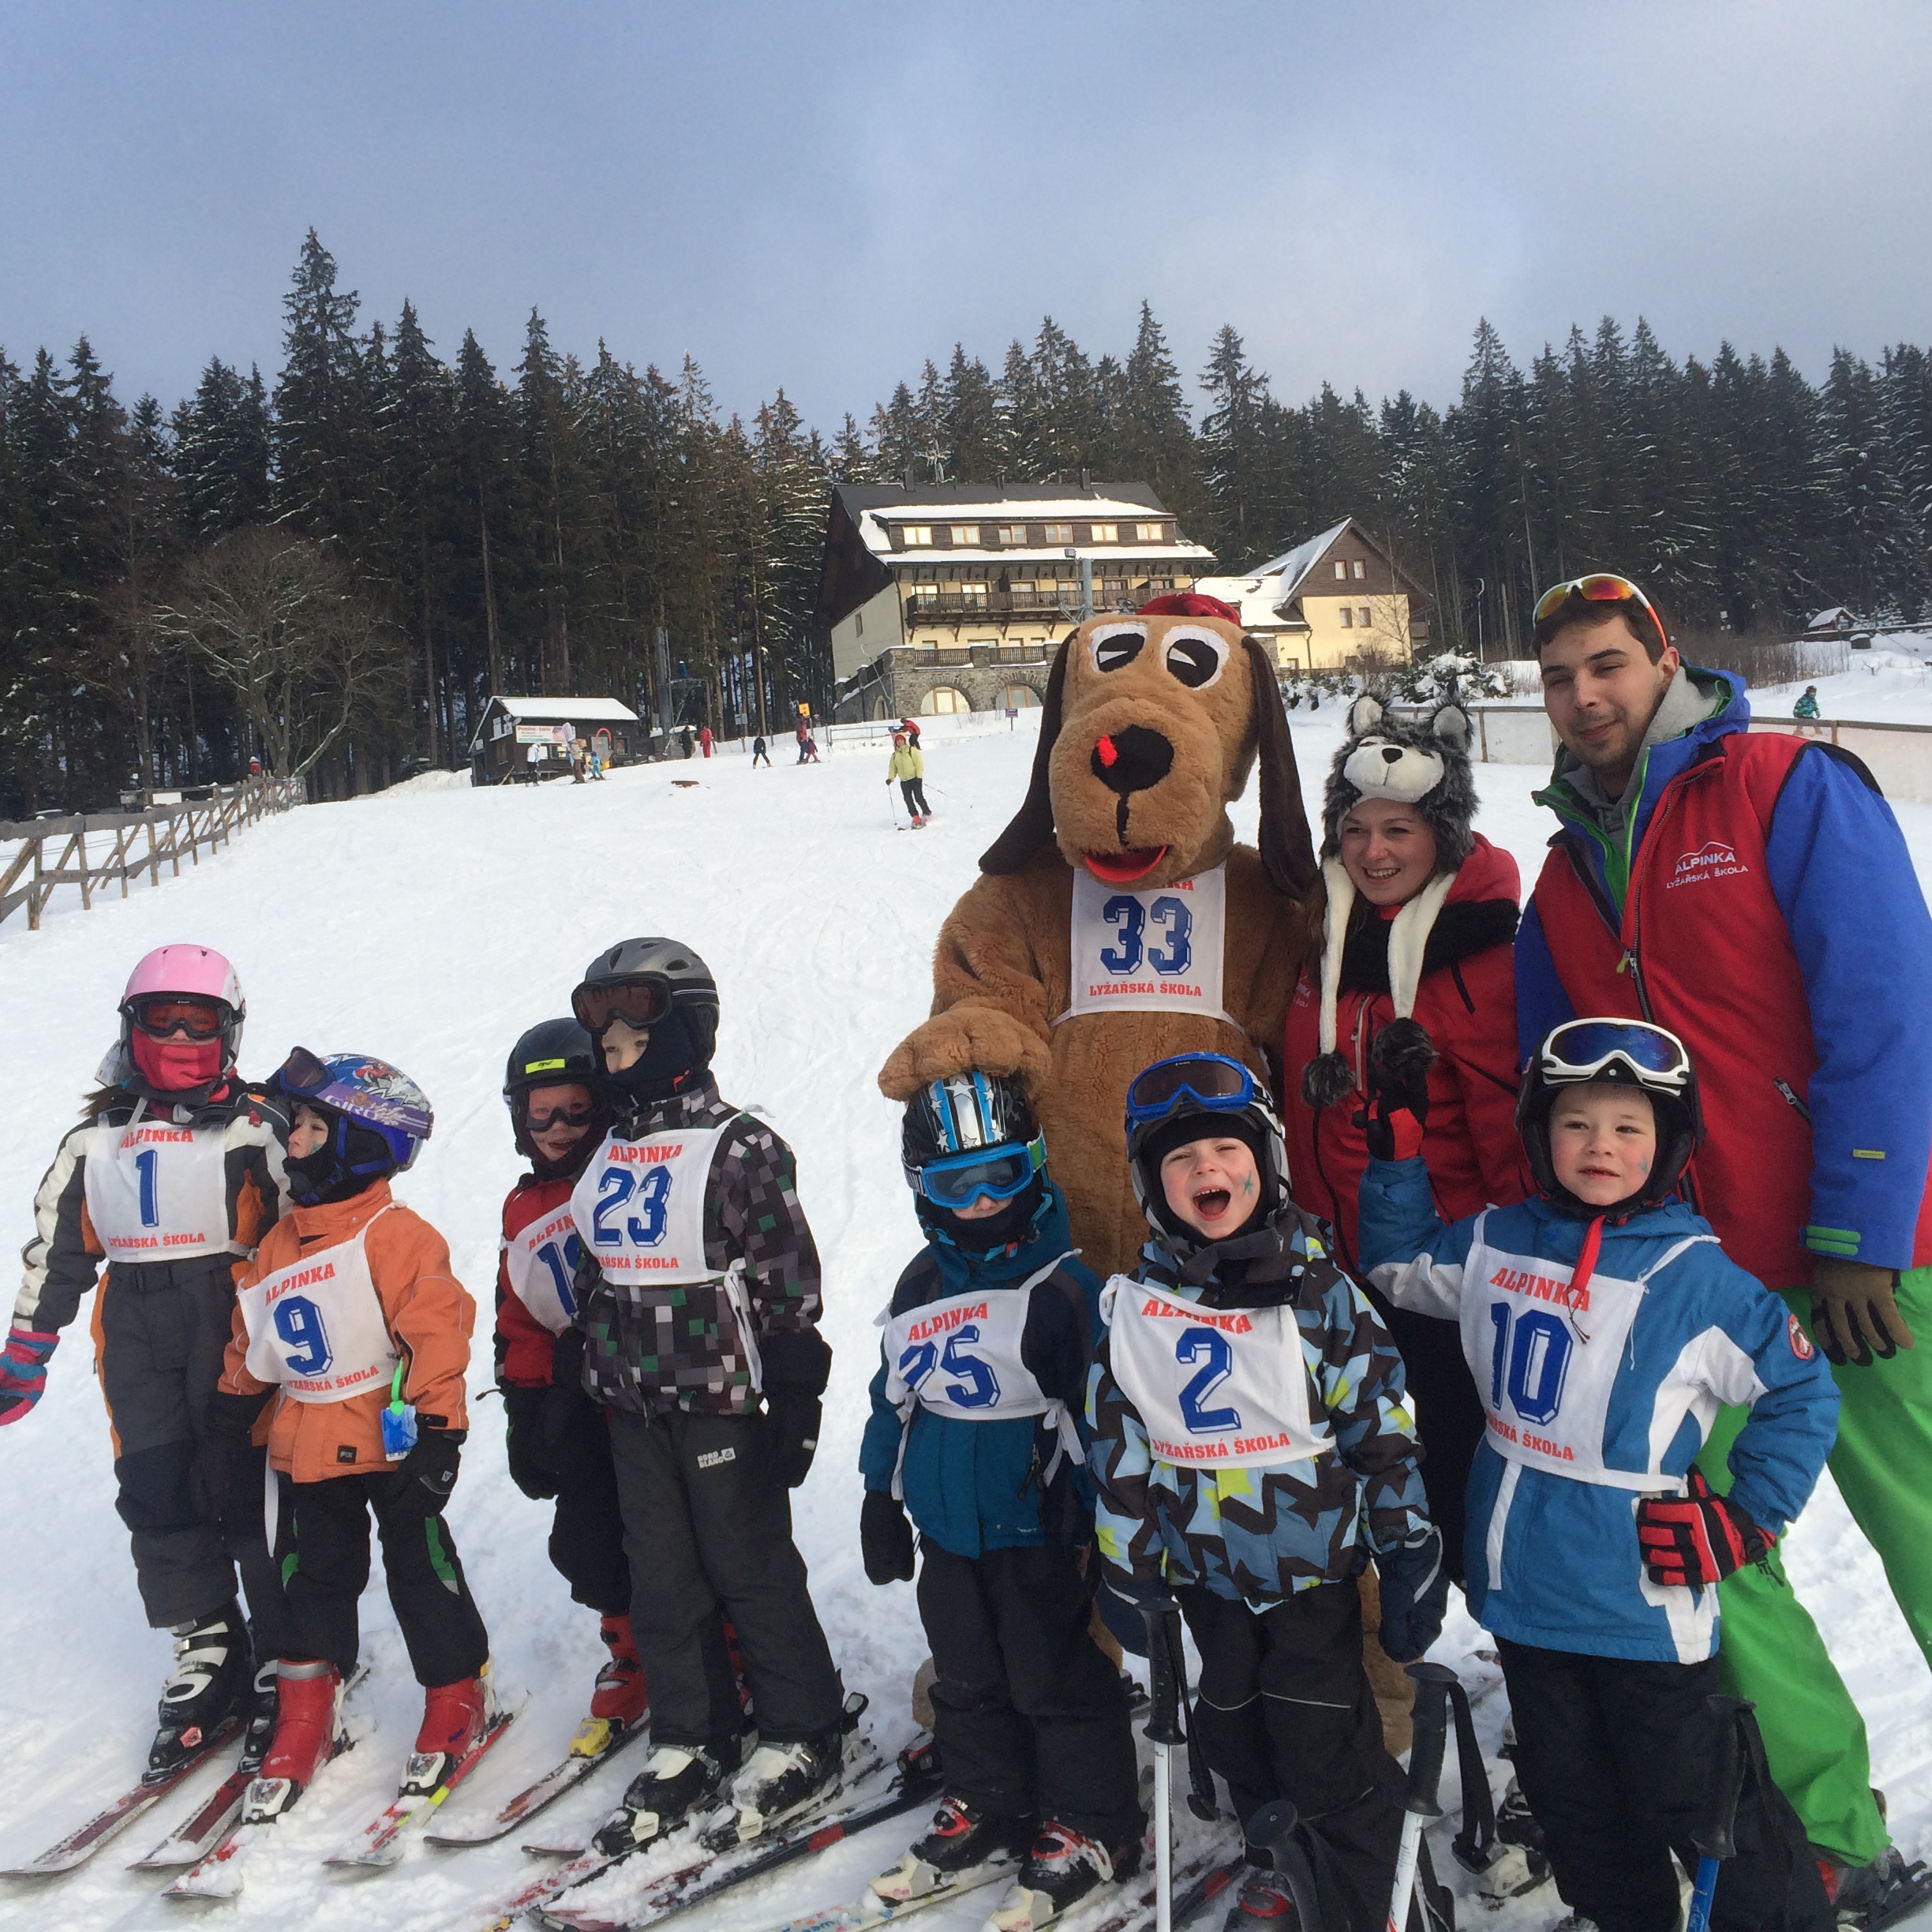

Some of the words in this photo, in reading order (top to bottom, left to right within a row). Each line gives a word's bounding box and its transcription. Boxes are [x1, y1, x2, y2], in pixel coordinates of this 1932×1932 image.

[1675, 852, 1735, 875] ALPINKA
[1713, 865, 1749, 878] ŠKOLA
[1100, 895, 1193, 976] 33
[1089, 979, 1155, 997] LYŽAŘSKÁ
[1159, 979, 1202, 997] ŠKOLA
[120, 1128, 193, 1149] ALPINKA
[607, 1144, 683, 1164] ALPINKA
[135, 1149, 159, 1228] 1
[593, 1165, 673, 1247] 23
[163, 1231, 206, 1247] ŠKOLA
[528, 1214, 576, 1252] ALPIN
[635, 1253, 680, 1269] ŠKOLA
[265, 1262, 335, 1307] ALPINKA
[1489, 1267, 1591, 1312] ALPINKA
[273, 1295, 333, 1378] 9
[908, 1302, 988, 1342] ALPINKA
[335, 1365, 380, 1388] ŠKOLA
[899, 1325, 1001, 1410] 25
[1175, 1327, 1242, 1435] 2
[1491, 1302, 1574, 1427] 10
[1151, 1438, 1229, 1459] LYŽAŘSKÁ
[1233, 1432, 1291, 1455] ŠKOLA
[1522, 1428, 1574, 1461] ŠKOLA
